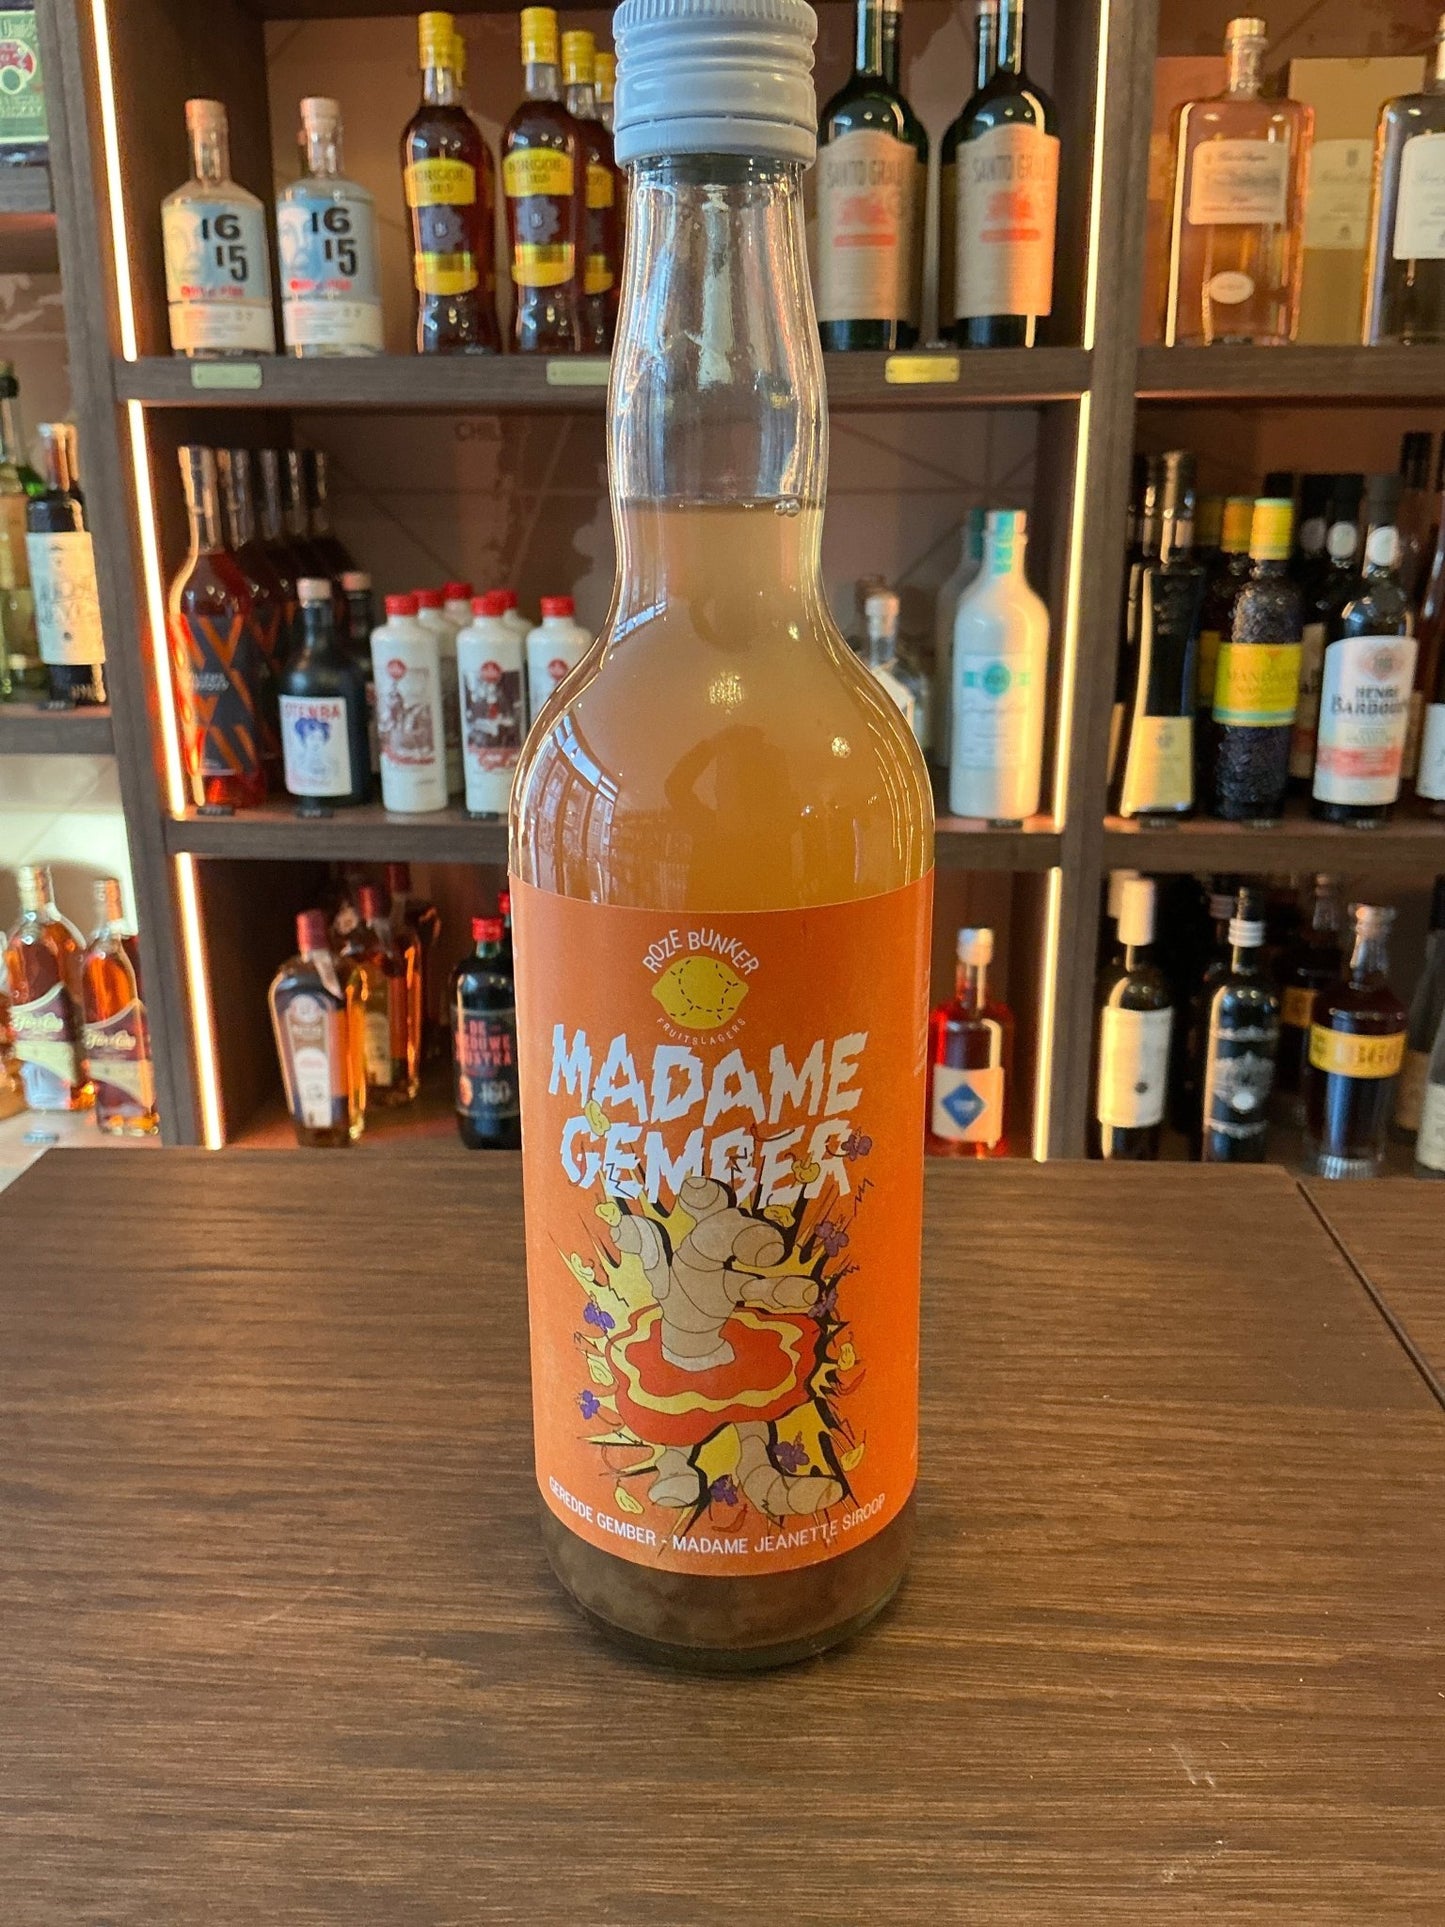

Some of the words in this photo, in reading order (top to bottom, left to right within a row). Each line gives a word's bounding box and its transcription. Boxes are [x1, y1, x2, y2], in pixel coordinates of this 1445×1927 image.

[202, 213, 241, 242] 16
[311, 207, 351, 234] 16
[216, 246, 248, 282] 15
[324, 239, 357, 277] 15
[642, 929, 683, 974] ROZE
[688, 927, 760, 976] BUNKER
[656, 1017, 746, 1046] FRUITSLAGERS
[548, 1023, 870, 1126] MADAME
[559, 1116, 853, 1210] GEMBER
[549, 1476, 594, 1524] GEREDDE
[597, 1512, 657, 1547] GEMBER
[671, 1534, 749, 1554] MADAME
[754, 1519, 839, 1553] JEANETTE
[842, 1492, 886, 1531] SIROOP
